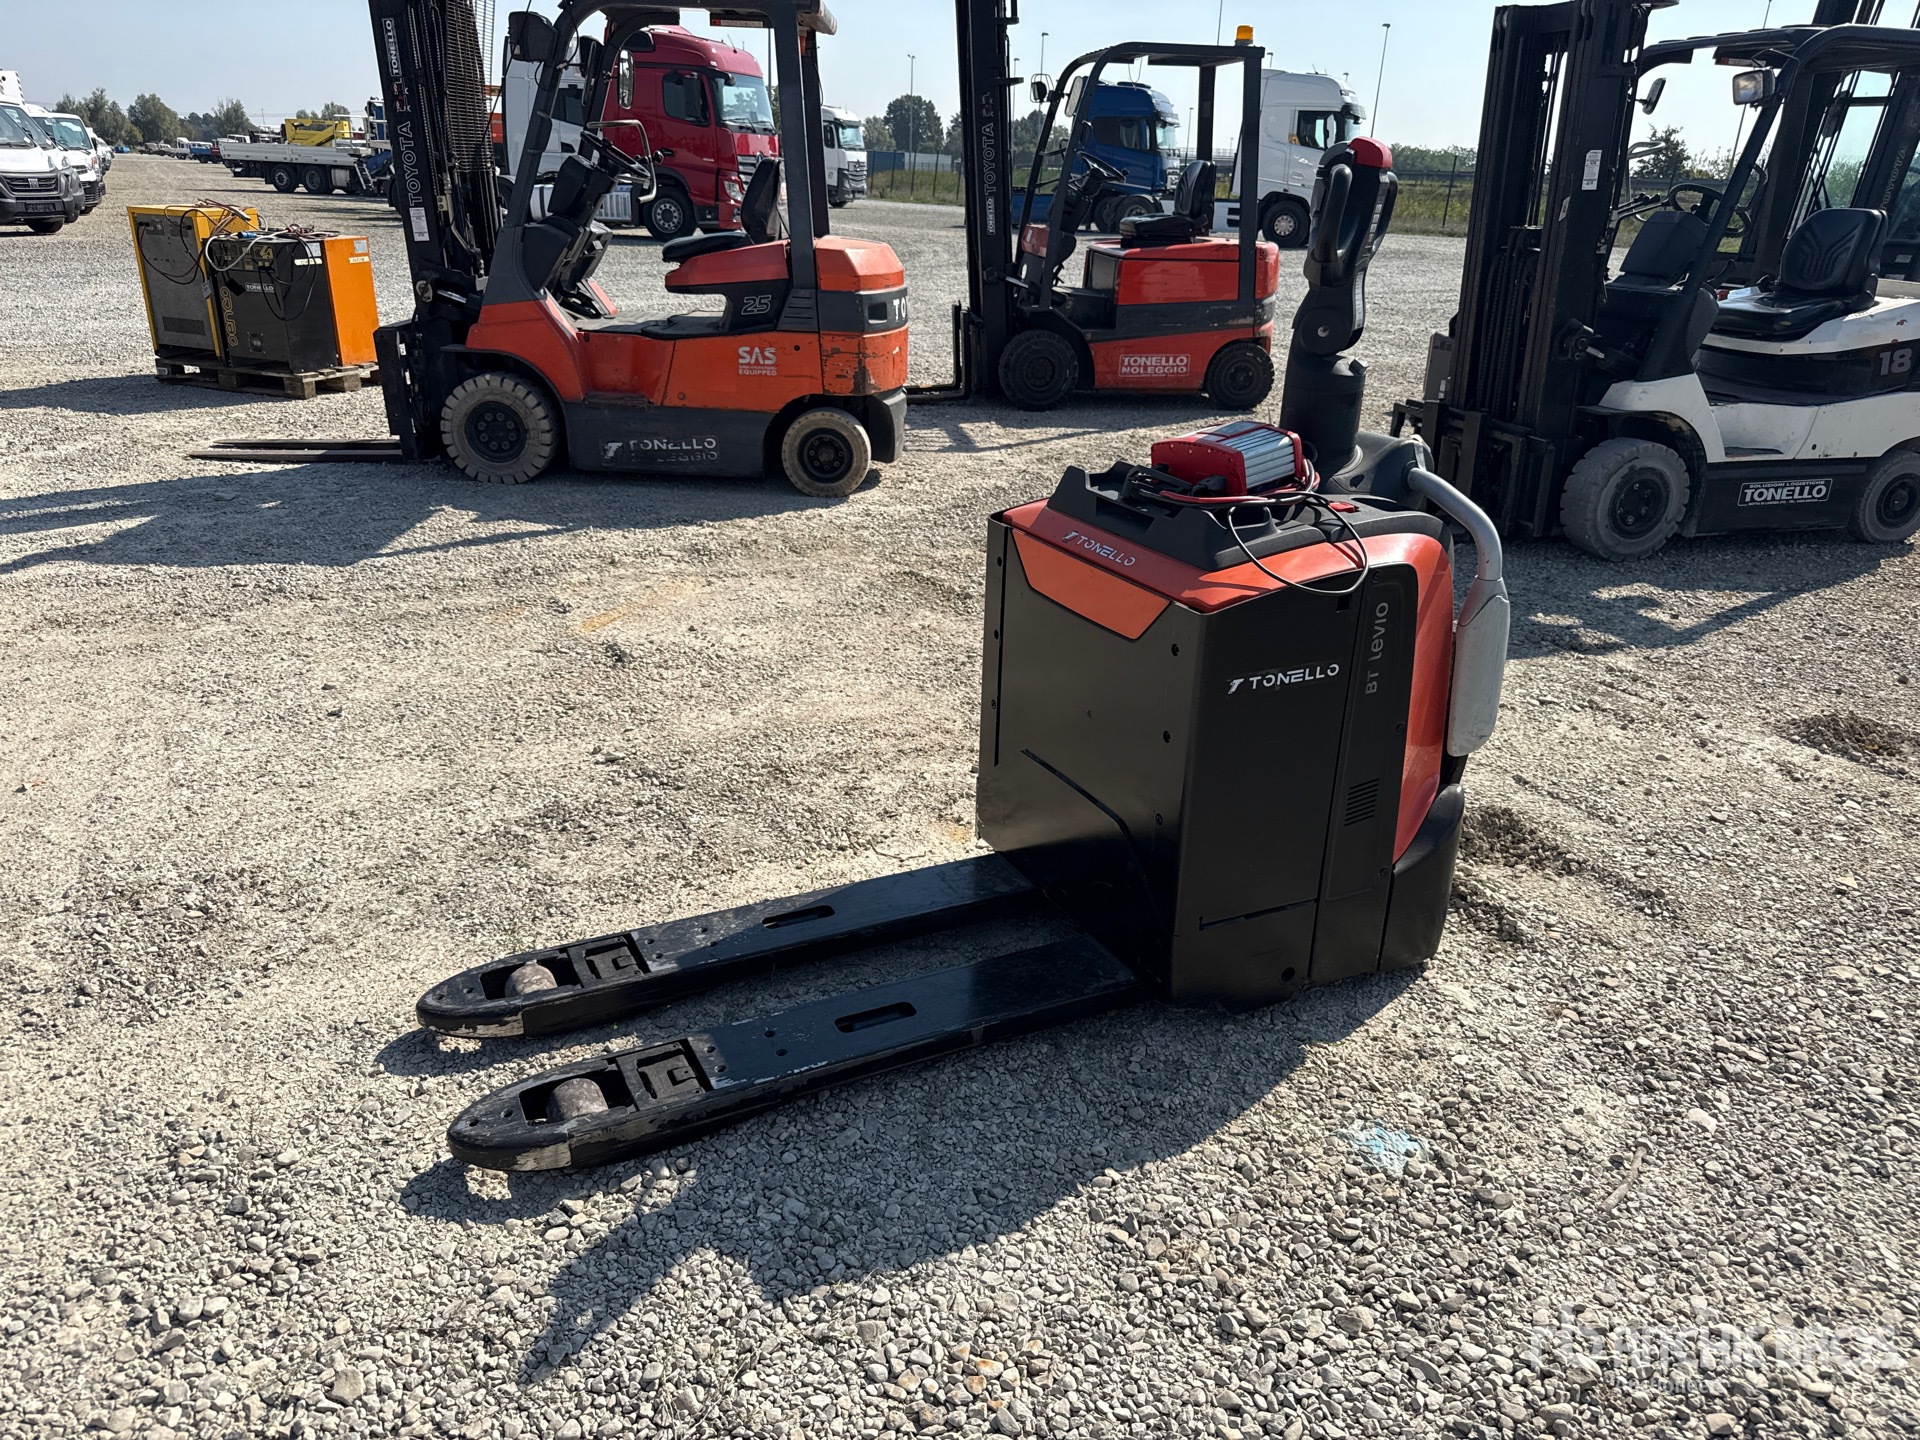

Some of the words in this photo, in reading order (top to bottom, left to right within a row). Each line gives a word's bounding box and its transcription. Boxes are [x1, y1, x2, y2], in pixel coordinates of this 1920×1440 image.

[385, 20, 399, 74] TONELLO
[397, 121, 423, 206] TOYOTA
[982, 122, 996, 196] TOYOTA
[741, 294, 771, 316] 25
[738, 346, 777, 365] SAS
[1122, 356, 1187, 366] TONELLO
[1880, 348, 1912, 376] 18
[738, 368, 777, 376] EQUIPPED
[1121, 366, 1187, 374] NOLEGGIO
[1744, 485, 1827, 502] TONELLO
[1077, 535, 1136, 566] TONELLO
[1249, 663, 1340, 690] TONELLO
[1365, 670, 1379, 695] BT
